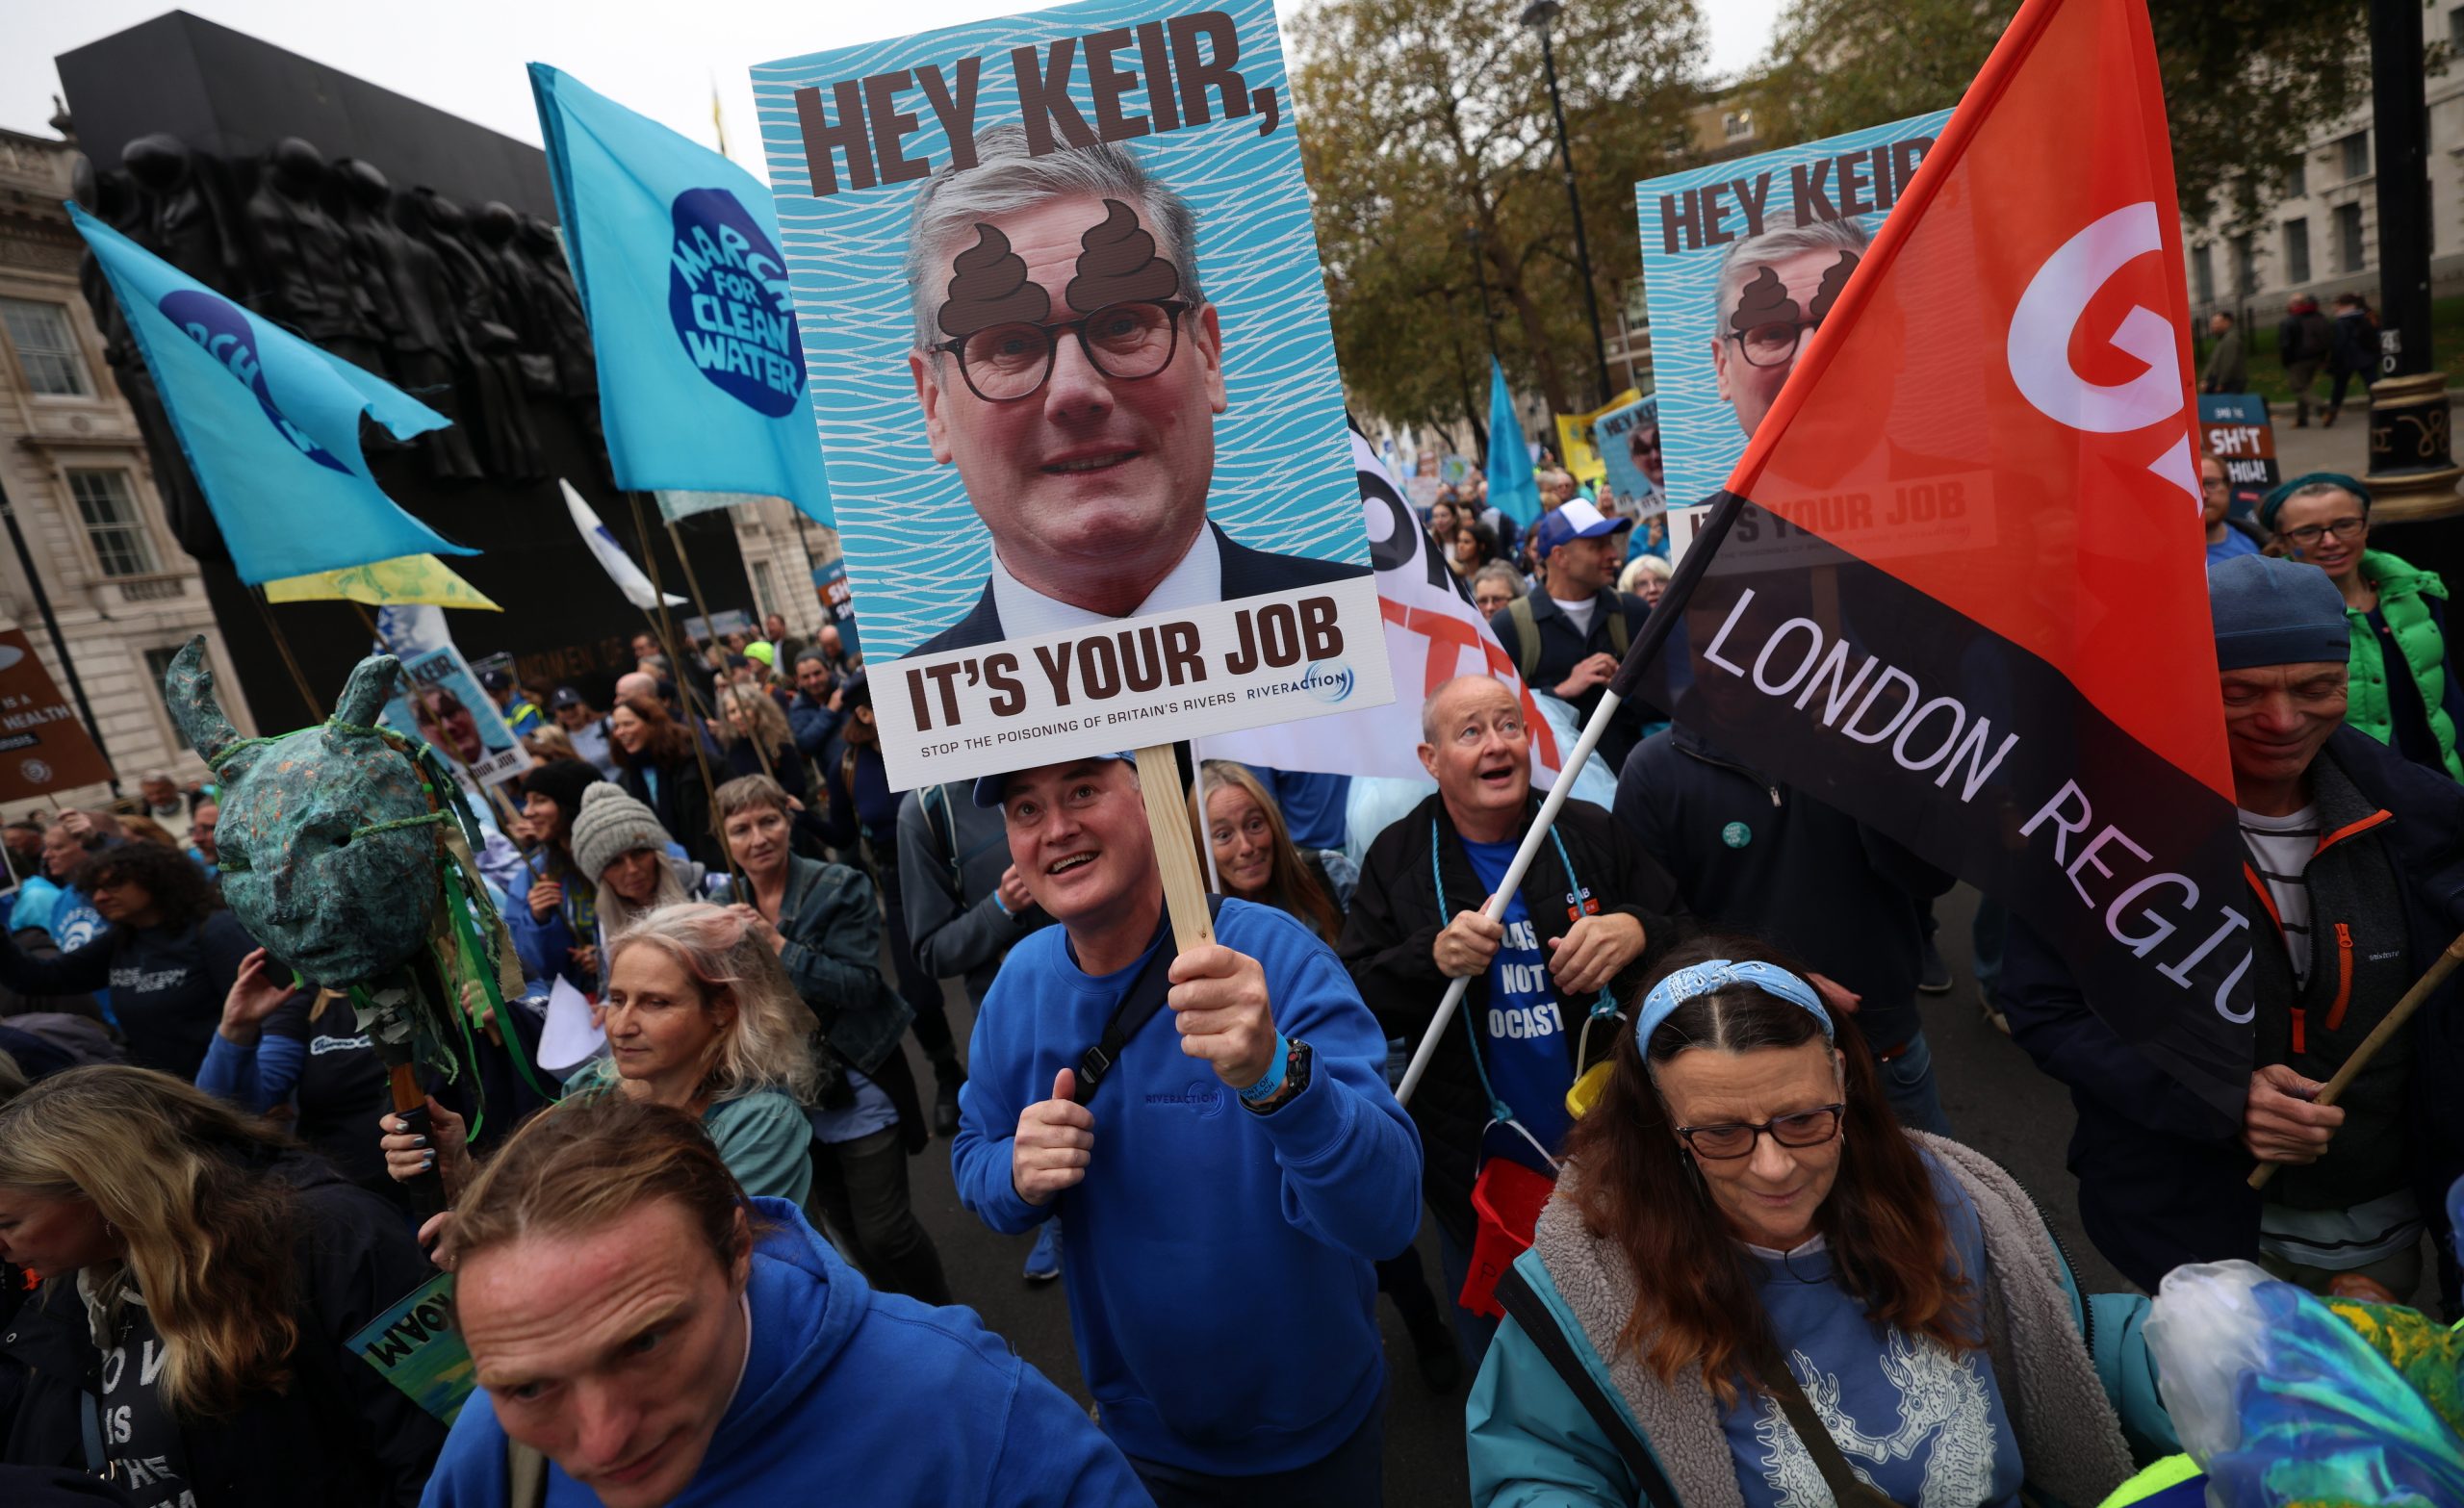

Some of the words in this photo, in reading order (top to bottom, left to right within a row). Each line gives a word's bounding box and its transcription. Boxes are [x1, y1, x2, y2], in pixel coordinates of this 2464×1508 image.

[794, 56, 982, 197] HEY
[1011, 11, 1279, 158] KEIR,
[1659, 171, 1772, 255] HEY
[712, 270, 760, 306] FOR
[692, 293, 789, 356] CLEAN
[685, 330, 798, 398] WATER
[1772, 492, 1875, 539] YOUR
[1886, 480, 1967, 526] JOB
[906, 652, 1027, 732] IT'S
[1033, 621, 1208, 707] YOUR
[1224, 596, 1345, 676] JOB
[1246, 672, 1348, 701] RIVERACTION
[921, 741, 960, 758] STOP
[964, 735, 992, 751] THE
[997, 719, 1079, 745] POISONING
[1084, 715, 1102, 728] OF
[1107, 702, 1179, 725] BRITAIN'S
[1183, 692, 1236, 711] RIVERS
[1703, 588, 2020, 804] LONDON
[1502, 963, 1545, 995] NOT
[1145, 1092, 1219, 1105] RIVERACTION
[105, 1404, 132, 1444] IS
